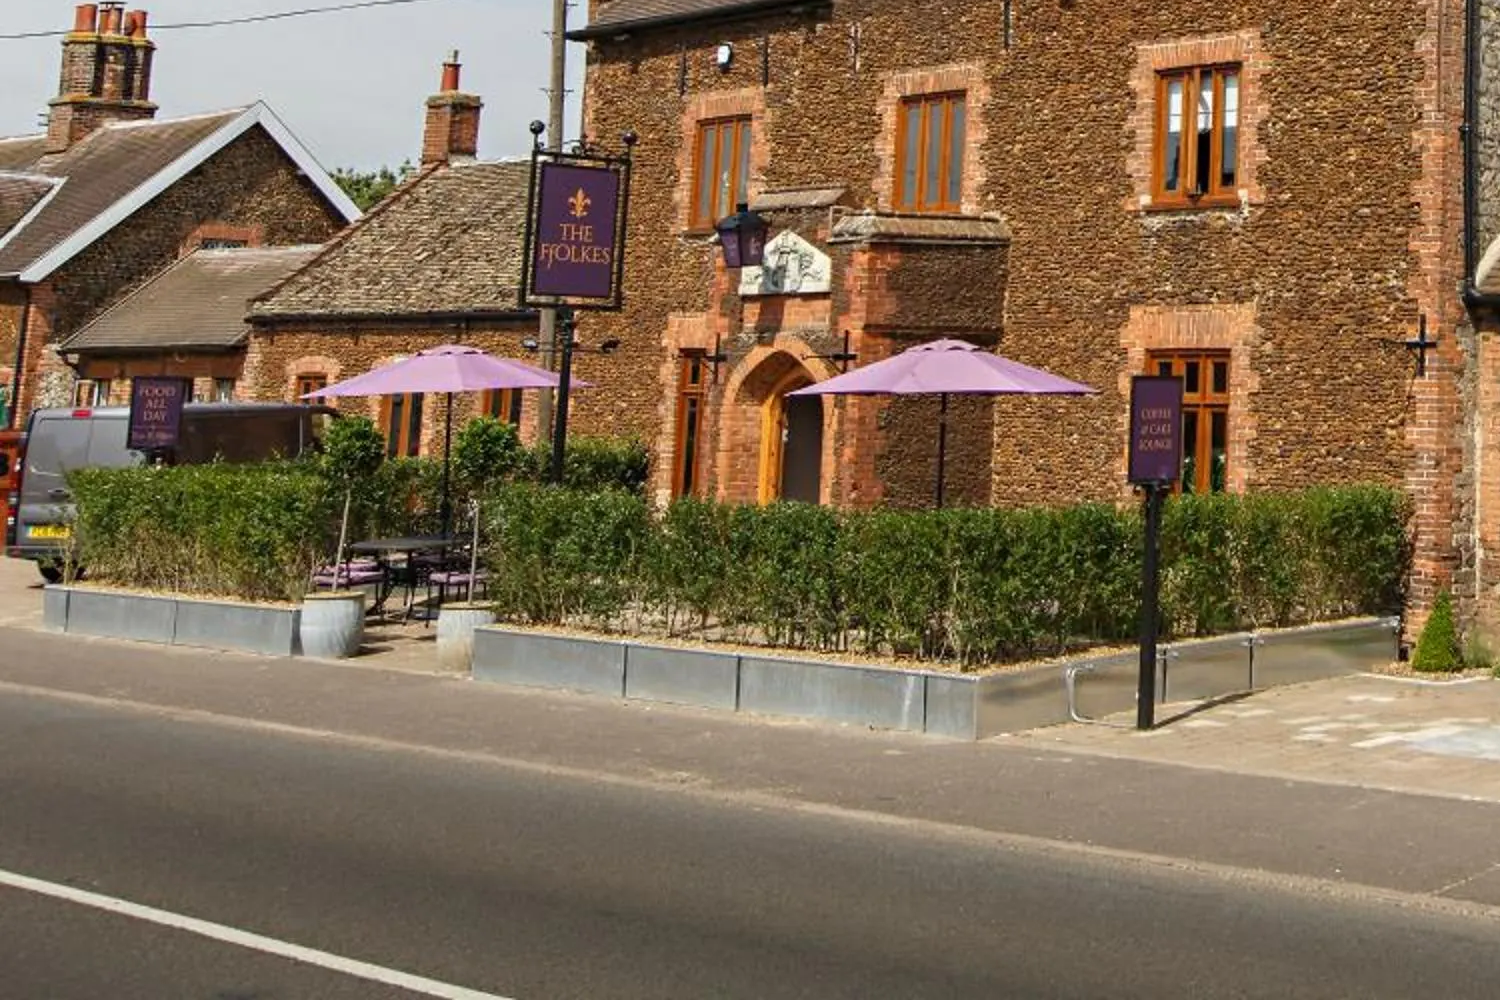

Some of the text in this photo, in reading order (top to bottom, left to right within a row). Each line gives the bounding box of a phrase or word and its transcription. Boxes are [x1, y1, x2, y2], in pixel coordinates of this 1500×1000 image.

[560, 223, 593, 243] THE
[140, 386, 176, 397] FOOD
[146, 399, 167, 409] ALL
[143, 411, 168, 421] DAY
[1141, 407, 1172, 419] COFFEE
[1149, 423, 1172, 435] CAKE
[1138, 439, 1173, 451] LOUNGE
